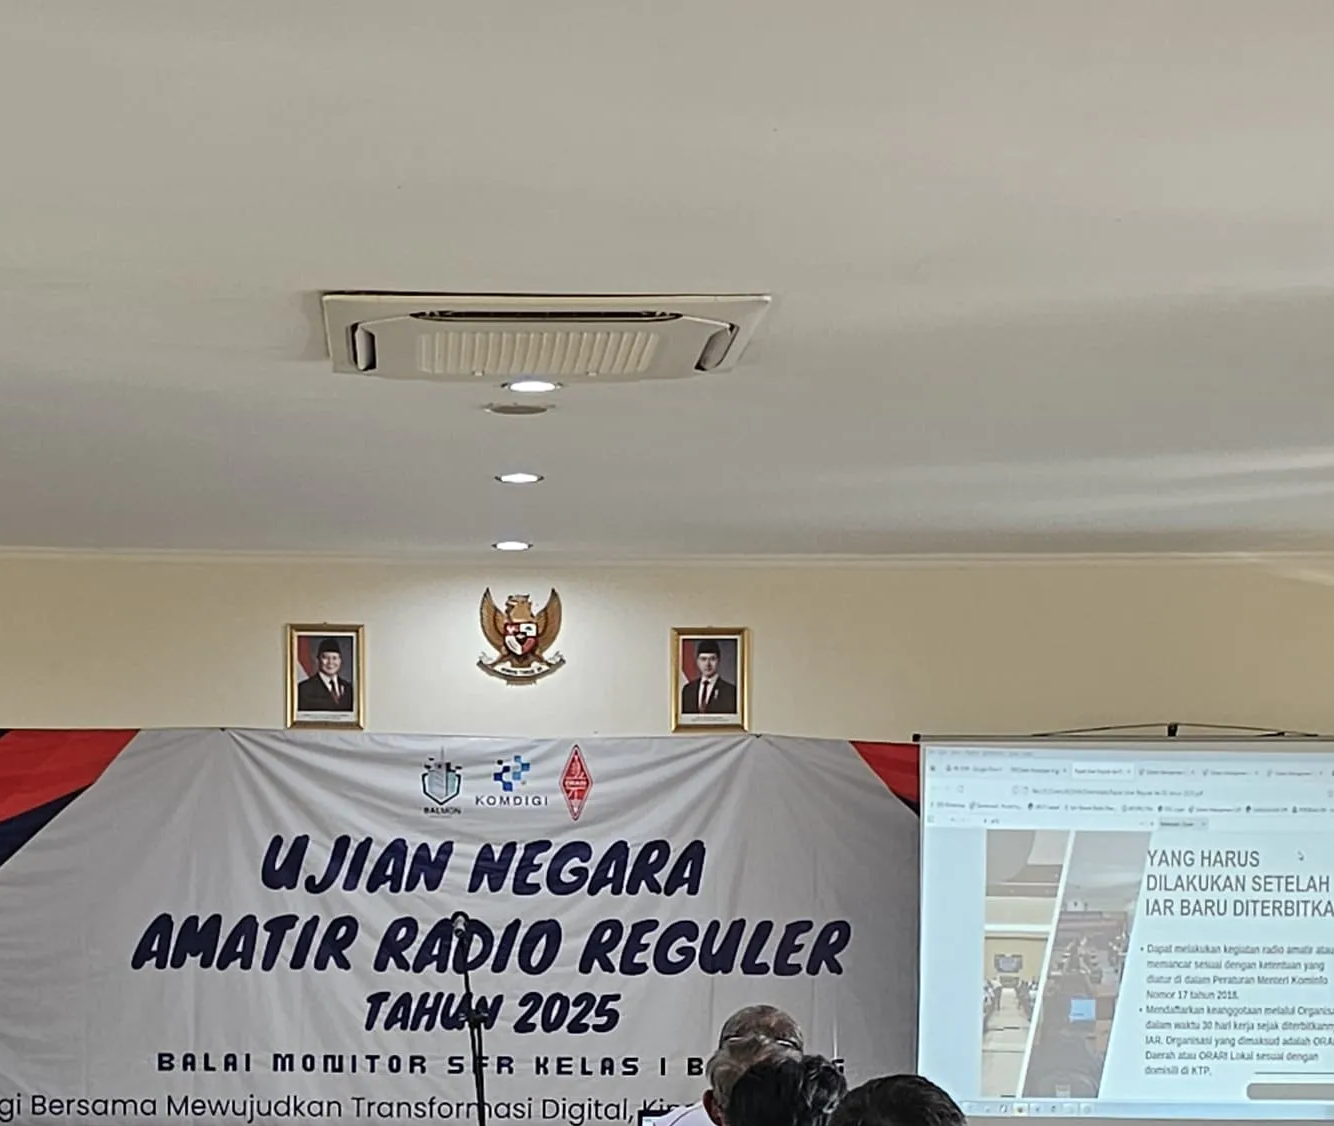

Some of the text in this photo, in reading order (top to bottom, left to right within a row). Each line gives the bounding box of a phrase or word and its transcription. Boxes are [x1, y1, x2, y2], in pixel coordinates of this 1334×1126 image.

[475, 795, 548, 806] KOMDIGI
[260, 834, 707, 897] UJIAN NEGARA
[1147, 850, 1260, 868] YANG HARUS
[1146, 875, 1330, 893] DILAKUKAN SETELAH
[1146, 899, 1174, 916] IAR
[1180, 900, 1227, 916] BARU
[130, 912, 853, 977] AMATIR RADIO REGULER
[1146, 991, 1176, 999] Nomor
[1178, 991, 1187, 999] 17
[365, 992, 622, 1034] TAHUN 2025
[157, 1053, 251, 1072] BALAI
[272, 1054, 427, 1075] MONITOR
[535, 1056, 639, 1076] KELAS
[30, 1094, 157, 1119] Bersama
[167, 1094, 343, 1126] Mewujudkan
[350, 1096, 534, 1122] Transformasi
[542, 1097, 635, 1126] Digital,
